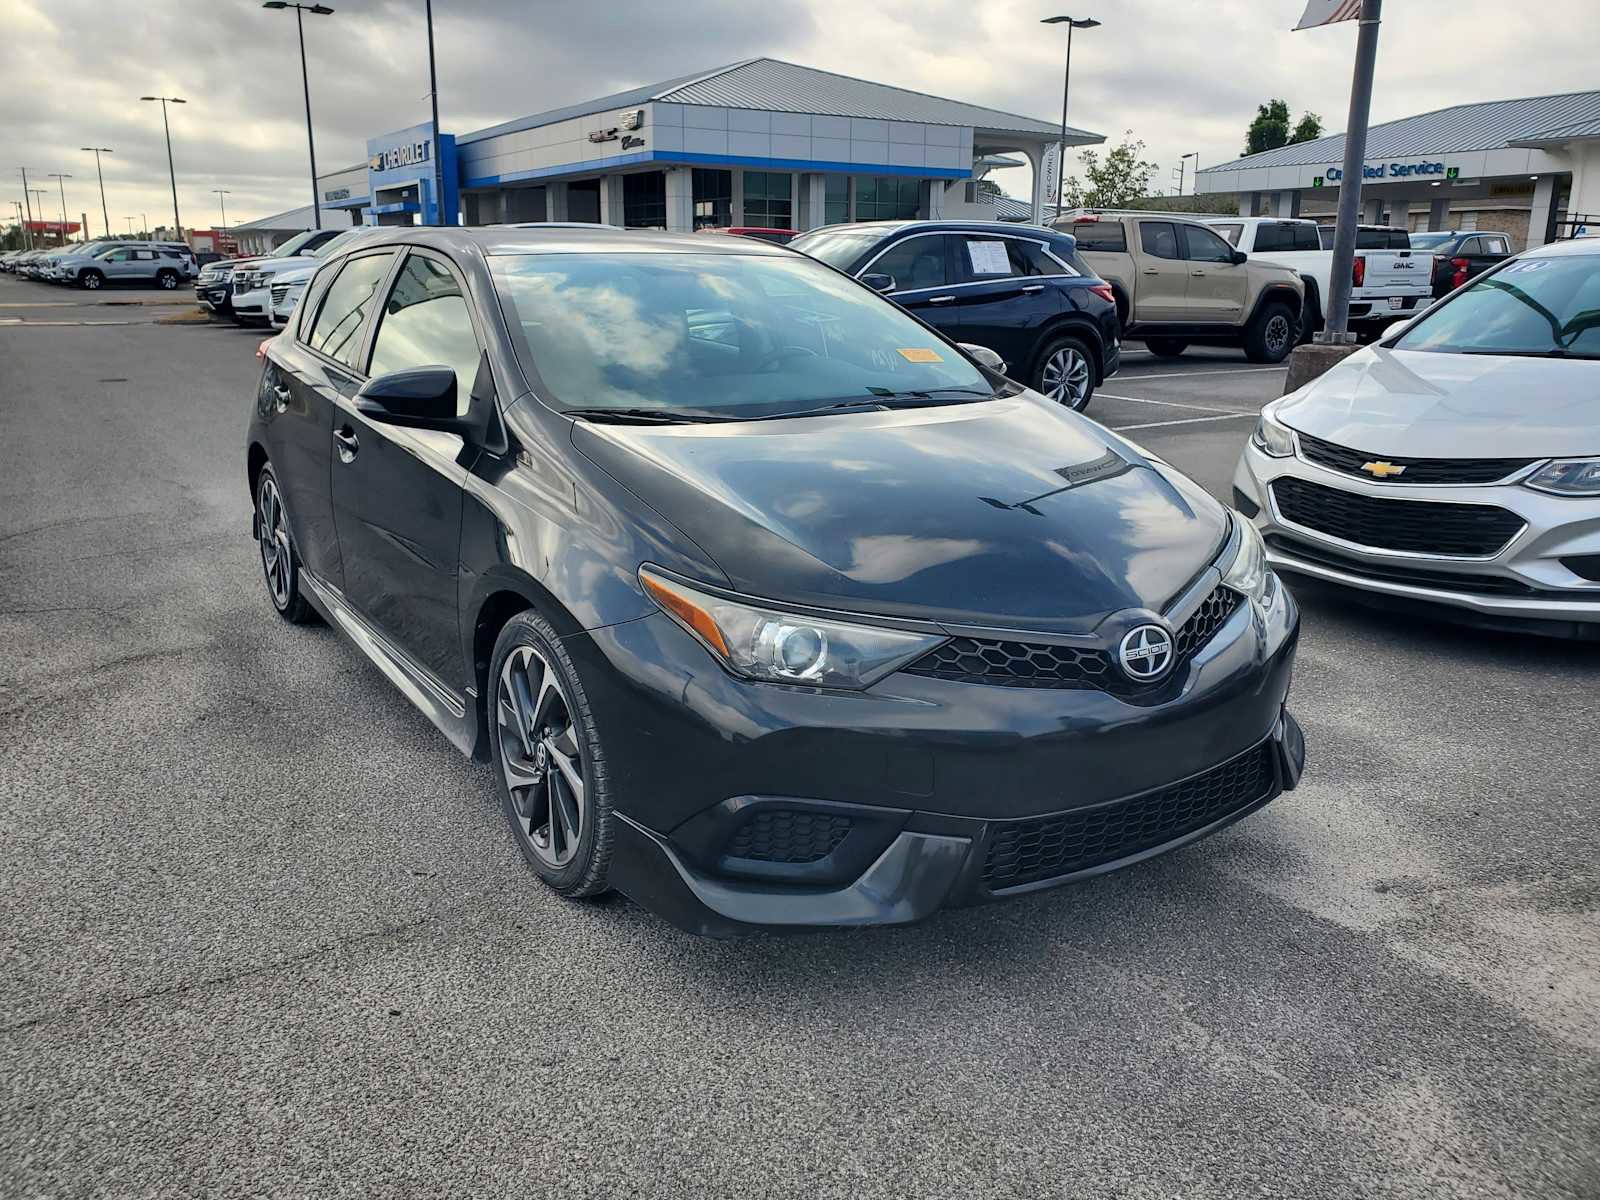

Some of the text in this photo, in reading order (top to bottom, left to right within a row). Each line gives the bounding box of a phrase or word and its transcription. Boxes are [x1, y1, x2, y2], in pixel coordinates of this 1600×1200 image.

[384, 140, 430, 169] CHEVROLET
[1326, 161, 1444, 180] Ceied Service
[1126, 642, 1168, 659] SCION
